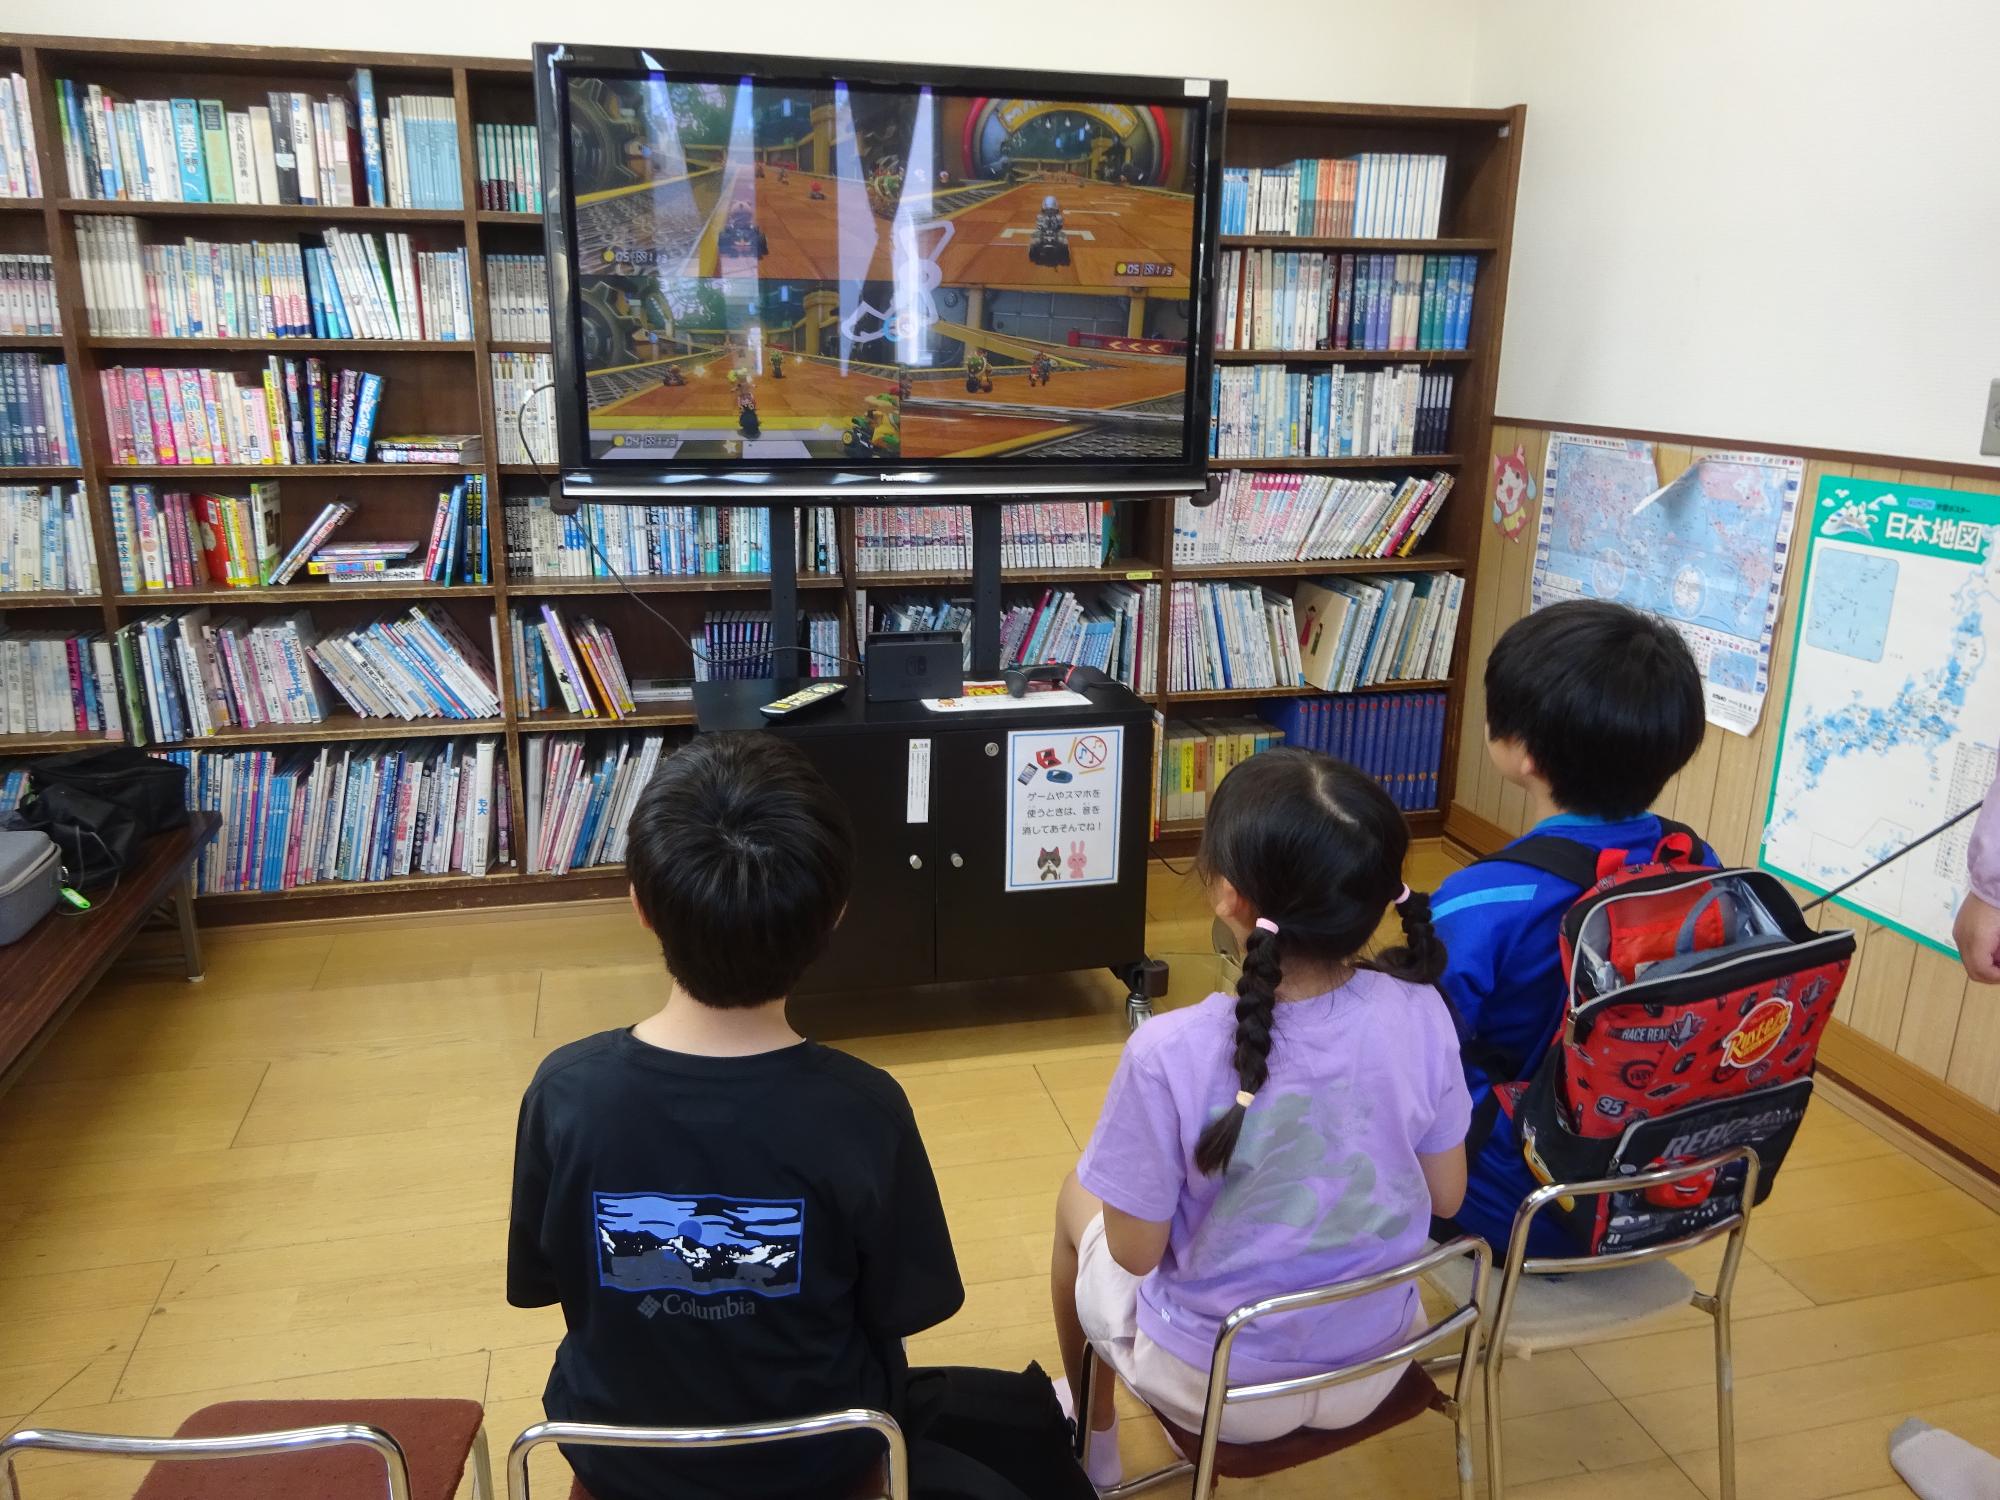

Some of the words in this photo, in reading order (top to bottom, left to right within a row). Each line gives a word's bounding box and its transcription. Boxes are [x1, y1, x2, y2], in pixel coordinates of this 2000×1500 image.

[1886, 512, 1982, 553] 日本地図
[1026, 789, 1101, 802] ゲームやスマホを
[1026, 805, 1101, 819] 使うときは、音を
[1622, 1027, 1646, 1041] RACE
[1599, 1097, 1622, 1115] 95
[662, 1294, 756, 1321] Columbia
